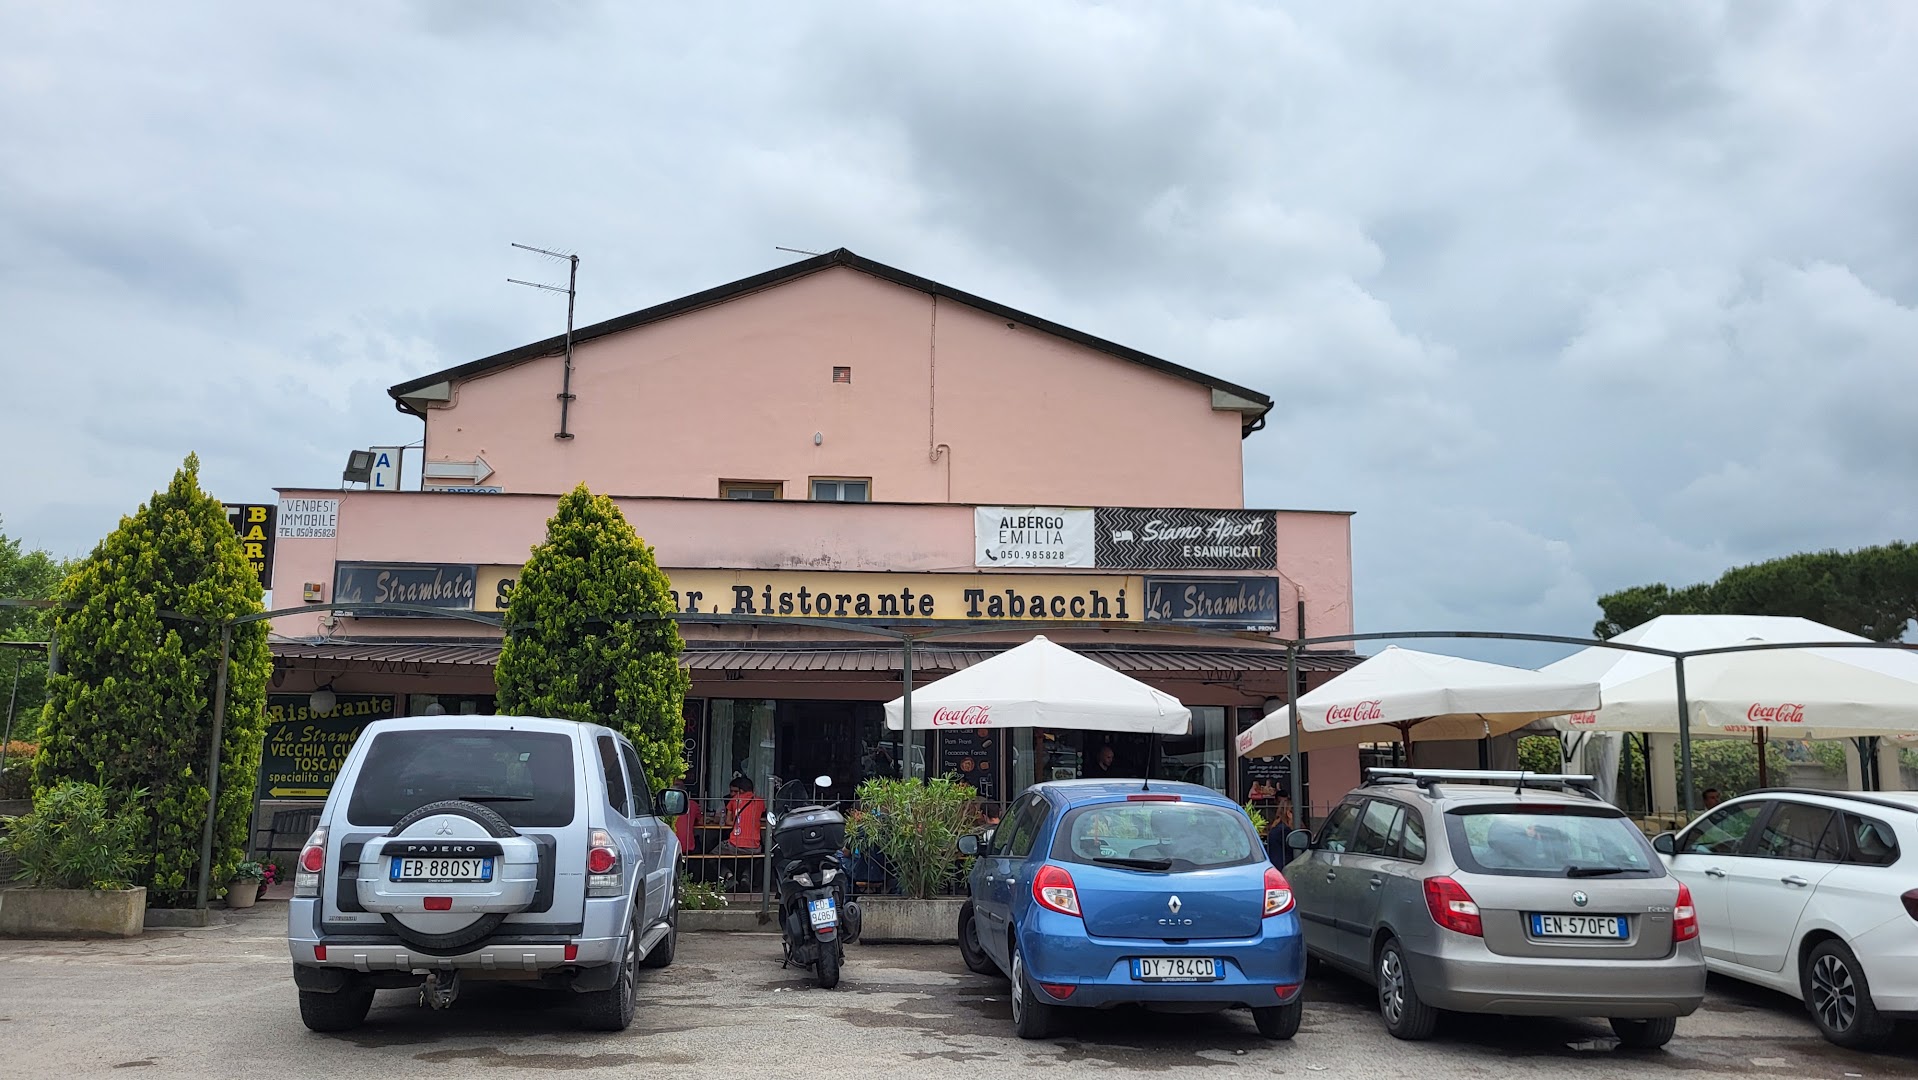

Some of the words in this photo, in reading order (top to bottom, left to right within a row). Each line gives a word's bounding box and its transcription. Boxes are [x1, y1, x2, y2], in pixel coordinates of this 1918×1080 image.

[286, 500, 334, 512] VENDESI
[280, 514, 336, 526] IMMOBILE
[1000, 516, 1064, 529] ALBERGO
[243, 507, 268, 558] BAR
[999, 530, 1064, 545] EMILIA
[1142, 520, 1202, 542] Siamo
[1206, 516, 1265, 545] Aperti
[1000, 550, 1065, 560] 050.985828
[1183, 546, 1191, 557] E
[1193, 545, 1261, 558] SANIFICATI
[336, 574, 363, 604] La
[374, 568, 474, 604] Strambata
[731, 584, 935, 617] Ristorante
[964, 588, 1130, 619] Tabacchi
[1147, 586, 1173, 620] La
[1183, 583, 1275, 618] Strambata
[932, 705, 991, 727] Coca-Cola
[1326, 700, 1383, 725] Coca-Cola
[1747, 702, 1806, 723] Coca-Cola
[272, 725, 294, 743] La
[300, 725, 360, 743] Stramb
[270, 743, 327, 758] VECCHIA
[294, 757, 345, 772] TOSCAN
[268, 771, 320, 784] specialità
[407, 845, 476, 853] PAJERO
[811, 910, 835, 923] 94867
[1158, 918, 1193, 926] CLIO
